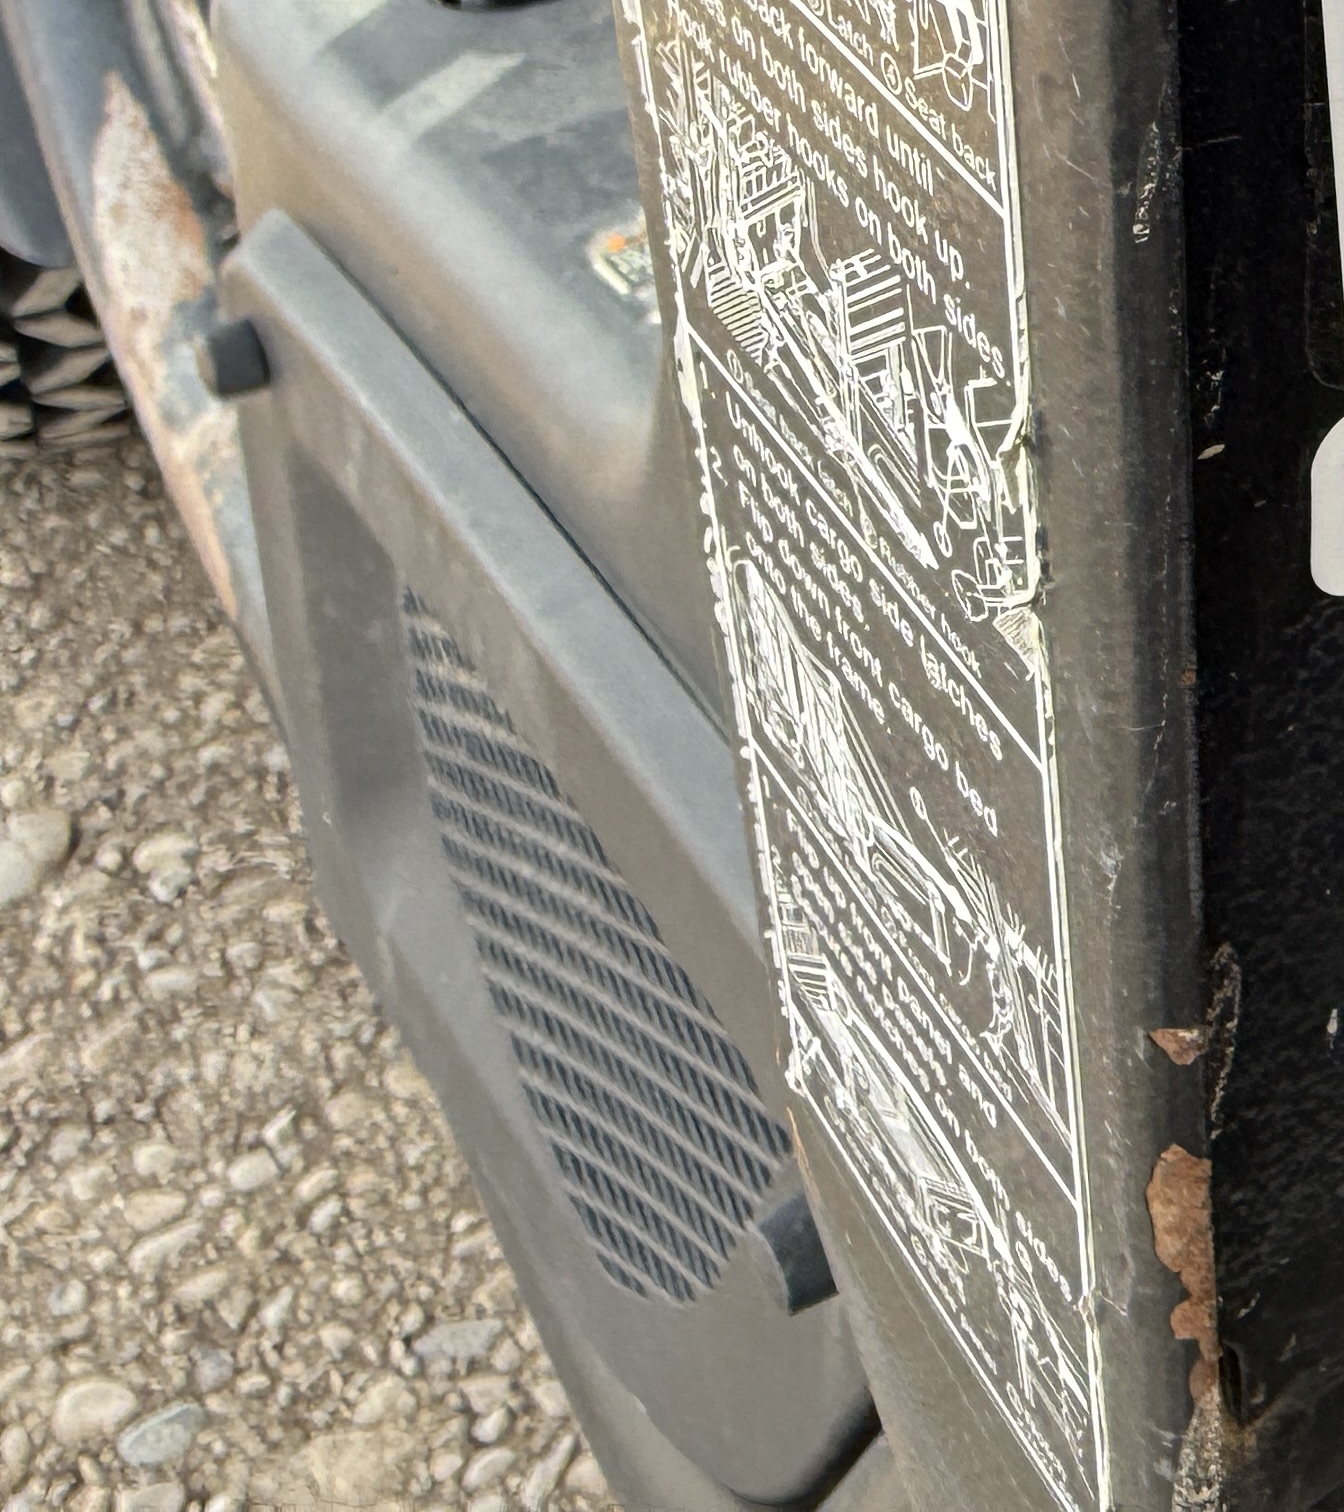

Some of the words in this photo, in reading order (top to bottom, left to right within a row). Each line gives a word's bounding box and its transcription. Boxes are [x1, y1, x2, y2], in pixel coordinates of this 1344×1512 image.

[719, 48, 781, 132] rubber
[786, 113, 849, 207] hooks
[855, 197, 881, 245] on
[888, 222, 936, 304] both
[944, 294, 1011, 386] sides.
[731, 15, 756, 59] on
[760, 39, 806, 112] both
[811, 100, 867, 178] sides
[873, 156, 928, 244] hook
[935, 230, 970, 289] up.
[798, 27, 879, 138] forward
[726, 391, 800, 506] Unhook
[805, 499, 863, 582] cargo
[869, 579, 913, 647] side
[920, 635, 1002, 760] latches
[733, 445, 756, 487] on
[761, 473, 804, 547] both
[778, 539, 830, 619] down
[835, 606, 882, 687] front
[889, 682, 948, 770] cargo
[955, 761, 997, 837] bed
